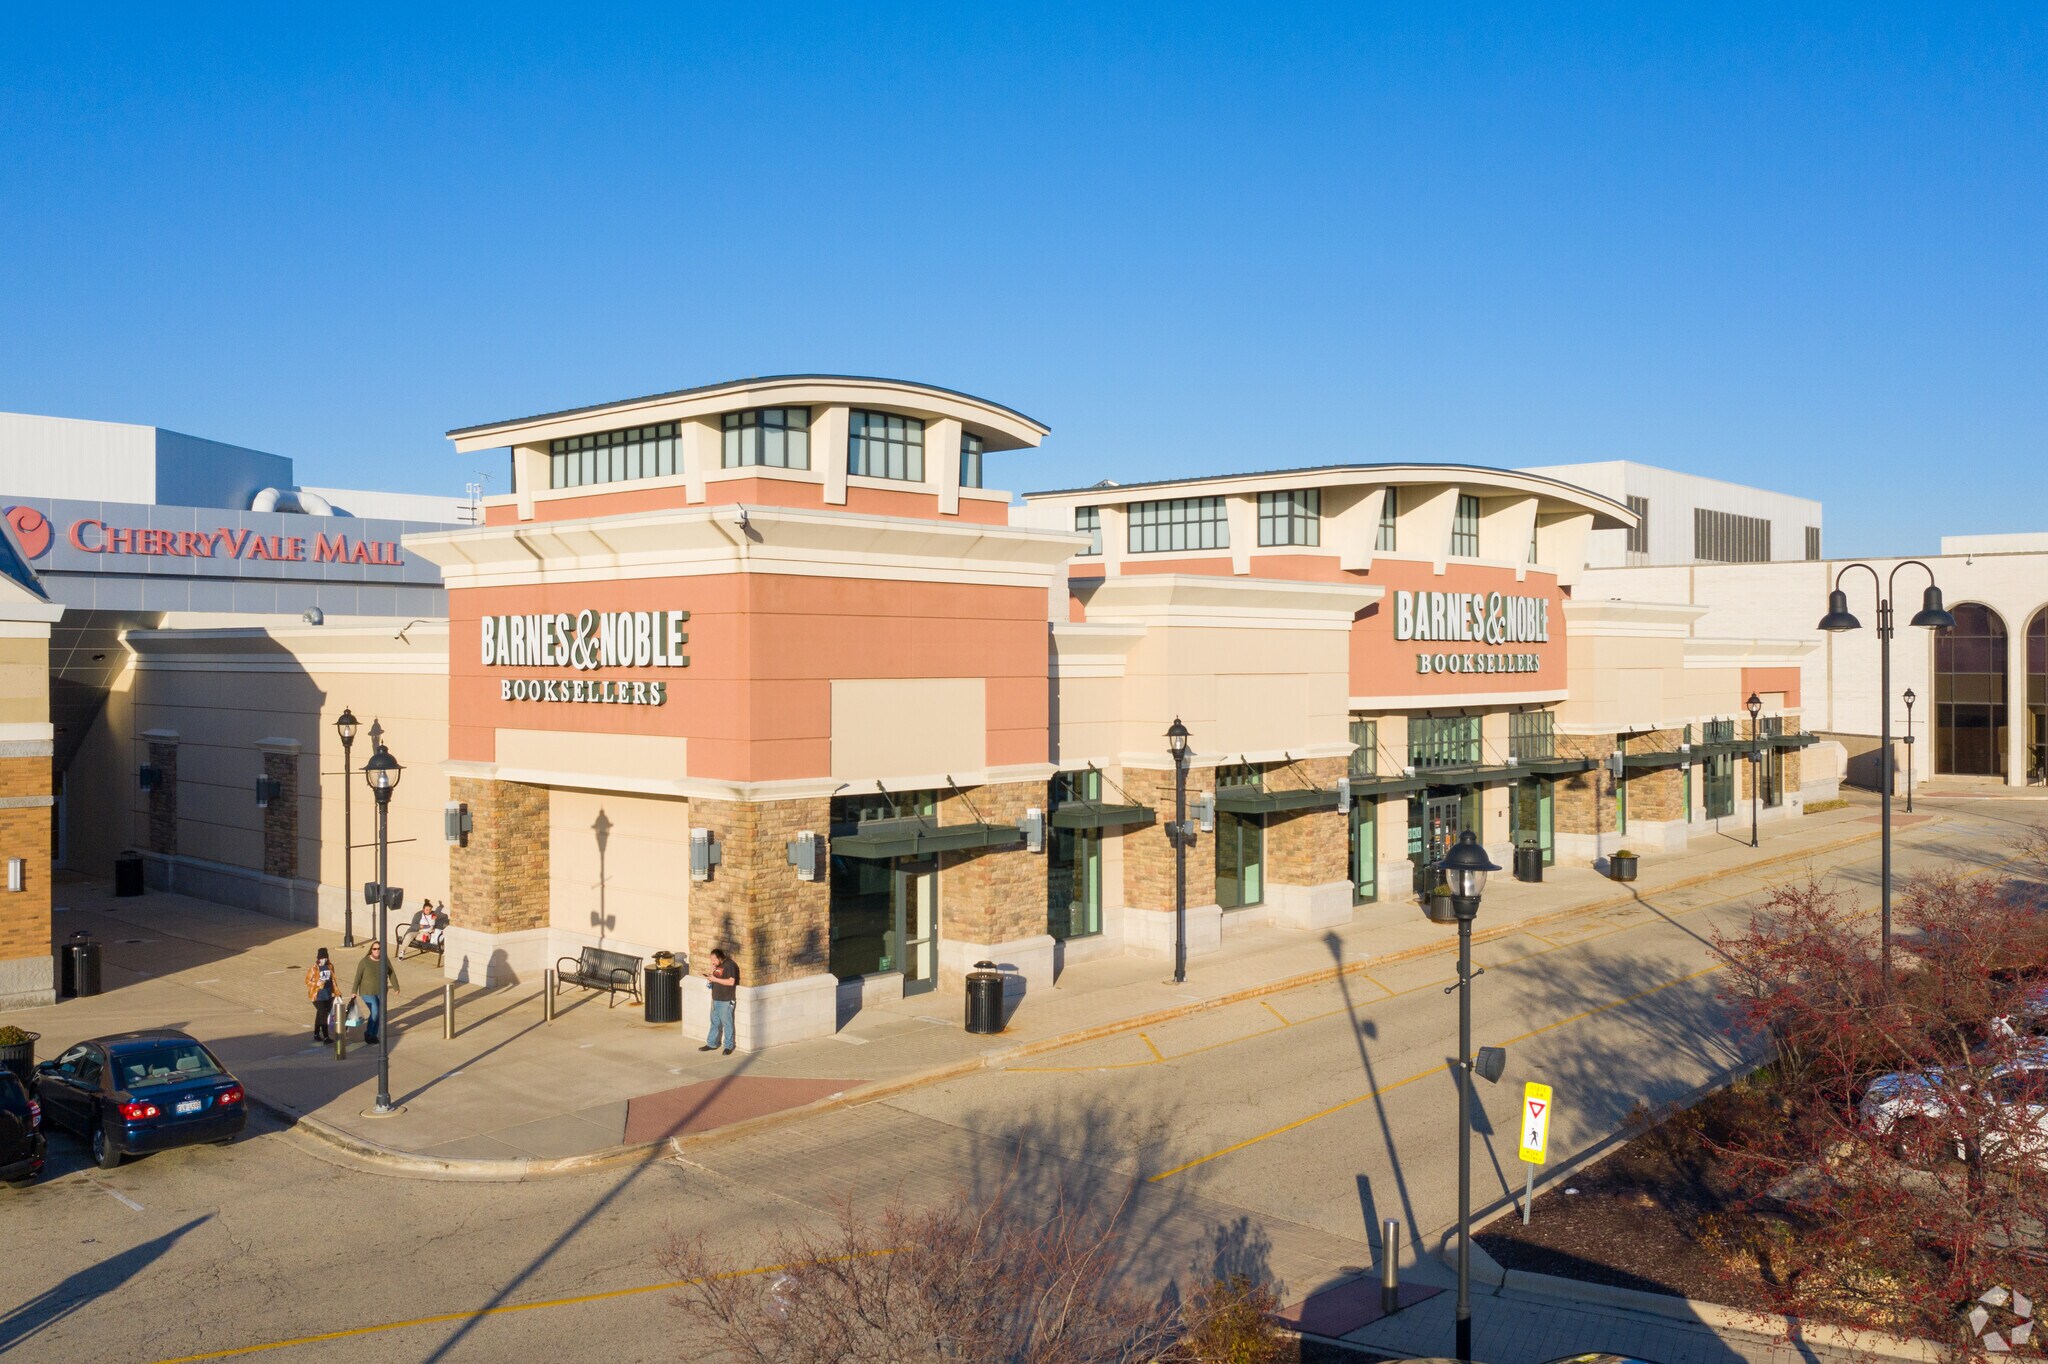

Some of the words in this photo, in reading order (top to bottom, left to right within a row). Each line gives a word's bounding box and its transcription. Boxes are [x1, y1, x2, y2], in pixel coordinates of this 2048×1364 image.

[313, 532, 405, 566] MALL
[1417, 653, 1540, 675] BOOKSELLERS
[501, 679, 667, 706] BOOKSELLERS
